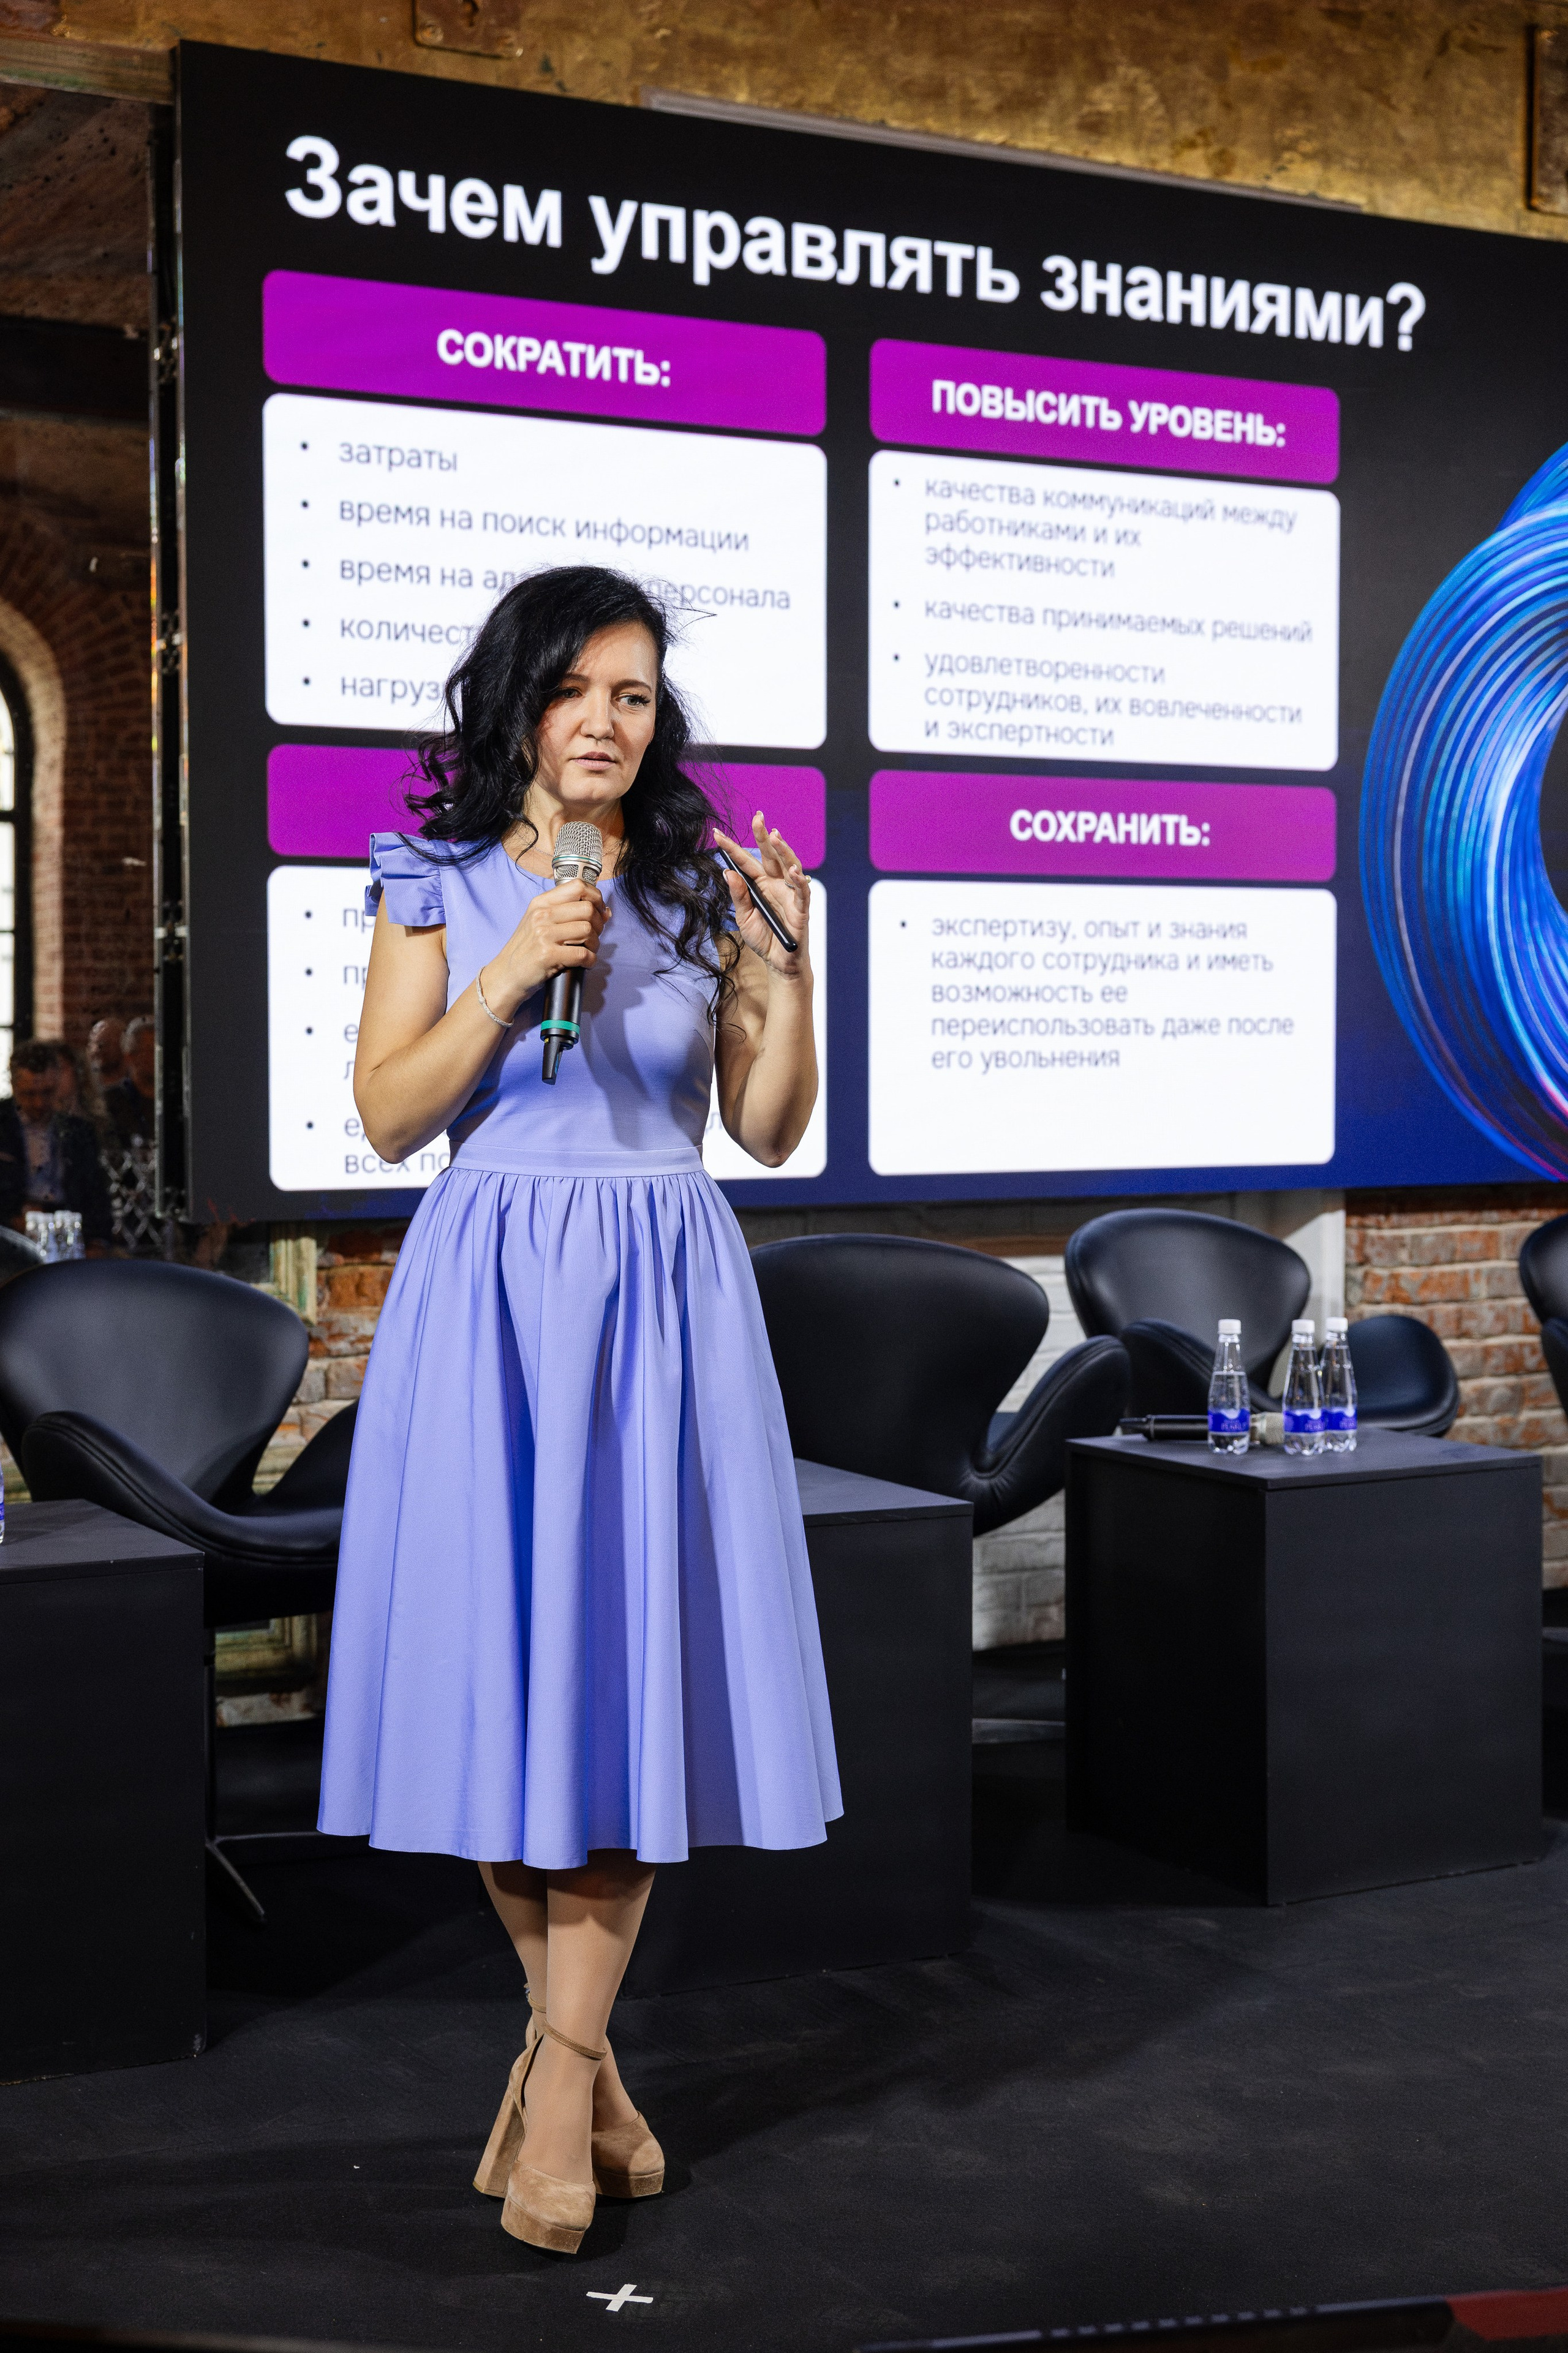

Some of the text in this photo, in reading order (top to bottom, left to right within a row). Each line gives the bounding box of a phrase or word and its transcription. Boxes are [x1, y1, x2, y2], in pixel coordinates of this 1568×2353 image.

[285, 136, 1425, 350] Зачем управлять знаниями?
[437, 330, 670, 387] СОКРАТИТЬ:
[932, 380, 1286, 447] ПОВЫСИТЬ УРОВЕНЬ:
[339, 442, 457, 472] затраты
[925, 480, 1296, 533] качества коммуникаций между
[340, 500, 748, 553] время на поиск информации
[925, 510, 1140, 545] работниками и их
[341, 559, 430, 587] время
[441, 567, 473, 588] на
[925, 544, 1114, 577] эффективности
[341, 618, 473, 645] количест
[925, 600, 1312, 642] качества принимаемых решений
[925, 653, 1165, 684] удовлетворенности
[341, 676, 446, 706] нагруз
[925, 687, 1301, 723] сотрудников, их вовлеченности
[925, 720, 1114, 746] и экспертности
[1011, 810, 1210, 846] СОХРАНИТЬ:
[932, 918, 1247, 943] экспертизу, опыт и знания
[932, 951, 1273, 975] каждого сотрудника и иметь
[932, 985, 1127, 1002] возможность ее
[932, 1017, 1294, 1040] переиспользовать даже после
[932, 1049, 1120, 1074] его увольнения
